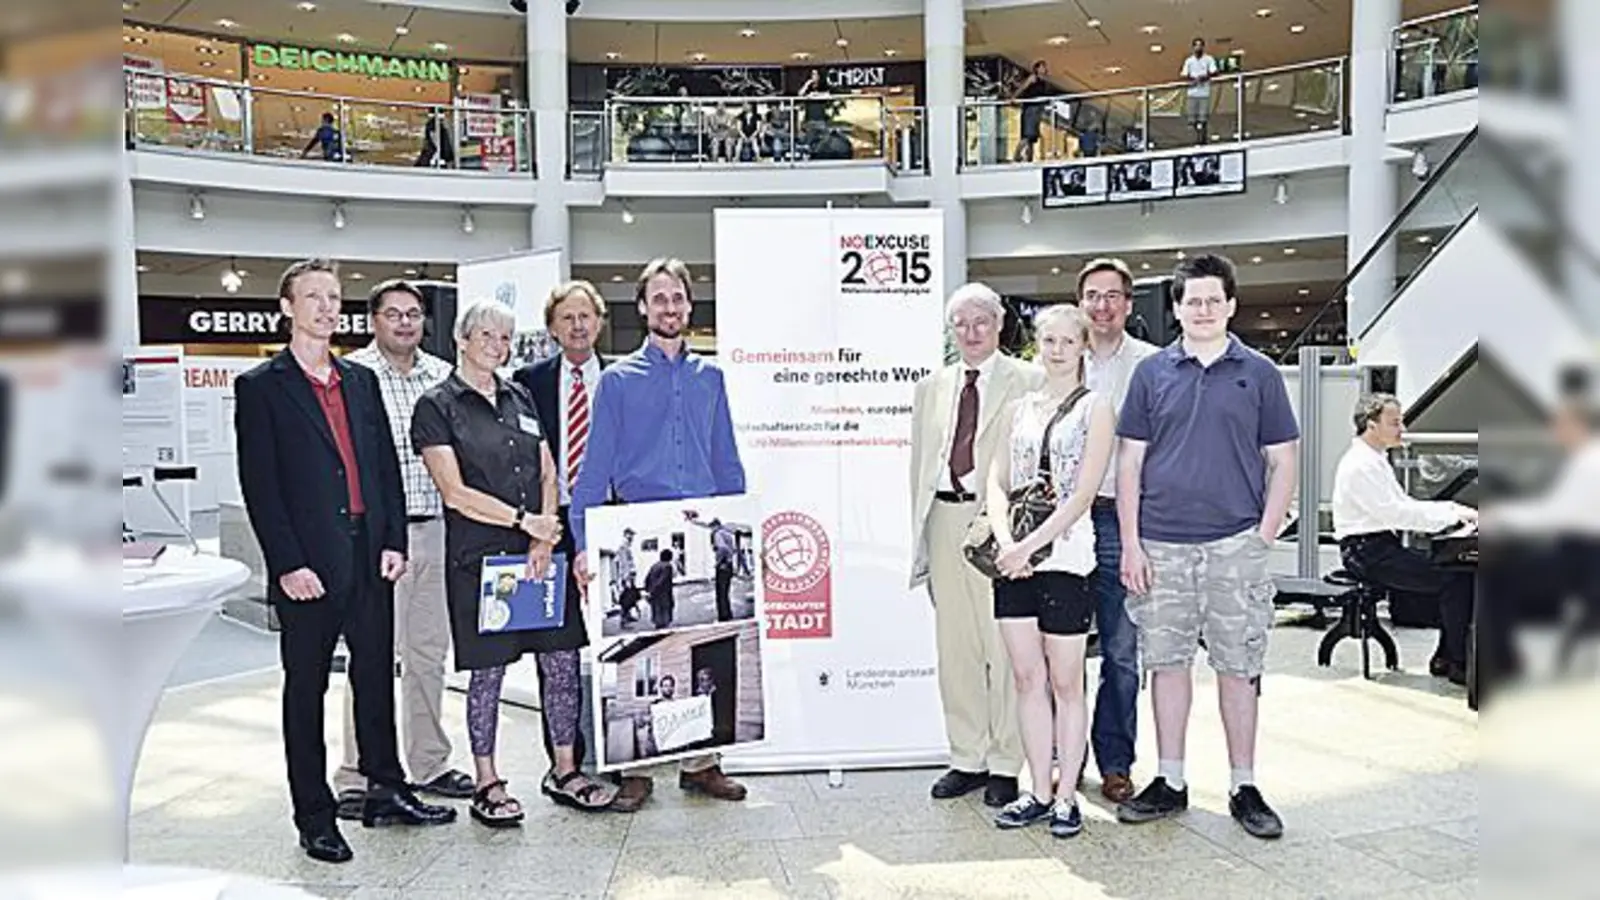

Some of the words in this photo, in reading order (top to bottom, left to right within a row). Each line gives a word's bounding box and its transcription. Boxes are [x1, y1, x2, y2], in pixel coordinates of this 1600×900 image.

[255, 44, 450, 82] DEICHMANN
[826, 66, 886, 86] CHRIST
[190, 311, 282, 333] GERRY
[731, 348, 835, 364] Gemeinsam
[838, 347, 862, 363] für
[773, 367, 811, 383] eine
[814, 367, 889, 386] gerechte
